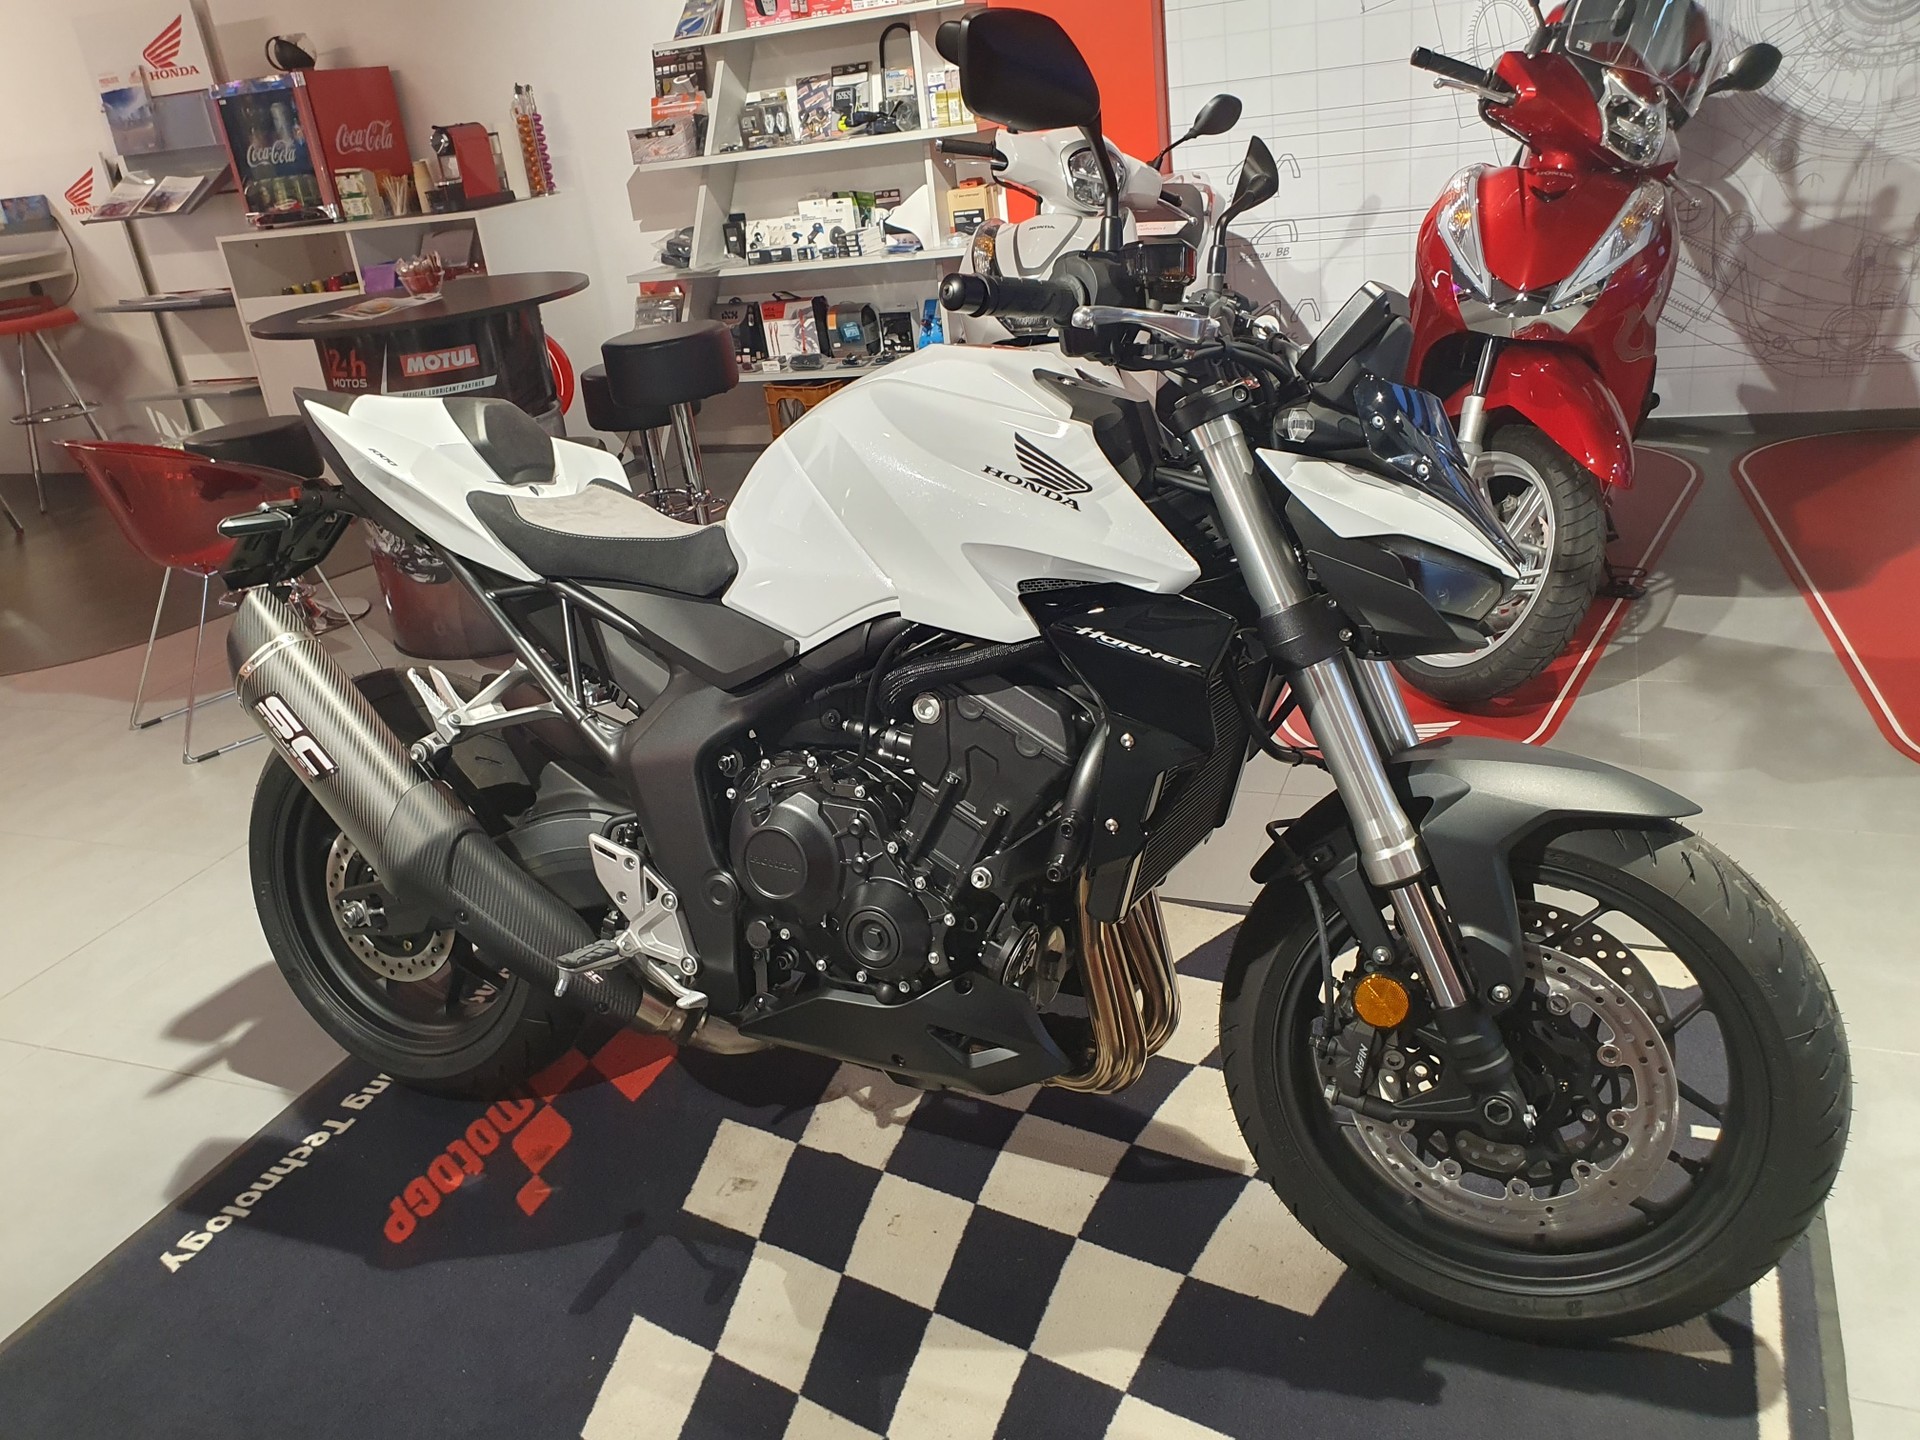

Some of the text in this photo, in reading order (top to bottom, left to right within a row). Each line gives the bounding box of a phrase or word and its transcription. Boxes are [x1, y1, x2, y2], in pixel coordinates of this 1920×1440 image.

[149, 65, 200, 81] HONDA
[335, 119, 393, 155] Coca-Cola
[247, 139, 296, 168] Coca-Cola
[1536, 170, 1574, 179] HONDA
[1276, 247, 1290, 257] BB
[406, 348, 476, 374] MOTUL
[332, 378, 368, 389] MOTOS
[428, 384, 460, 397] LUBRICANT
[461, 380, 485, 391] PARTNER
[981, 465, 1082, 512] HONDA
[258, 696, 334, 776] SC
[159, 1118, 357, 1273] Technology
